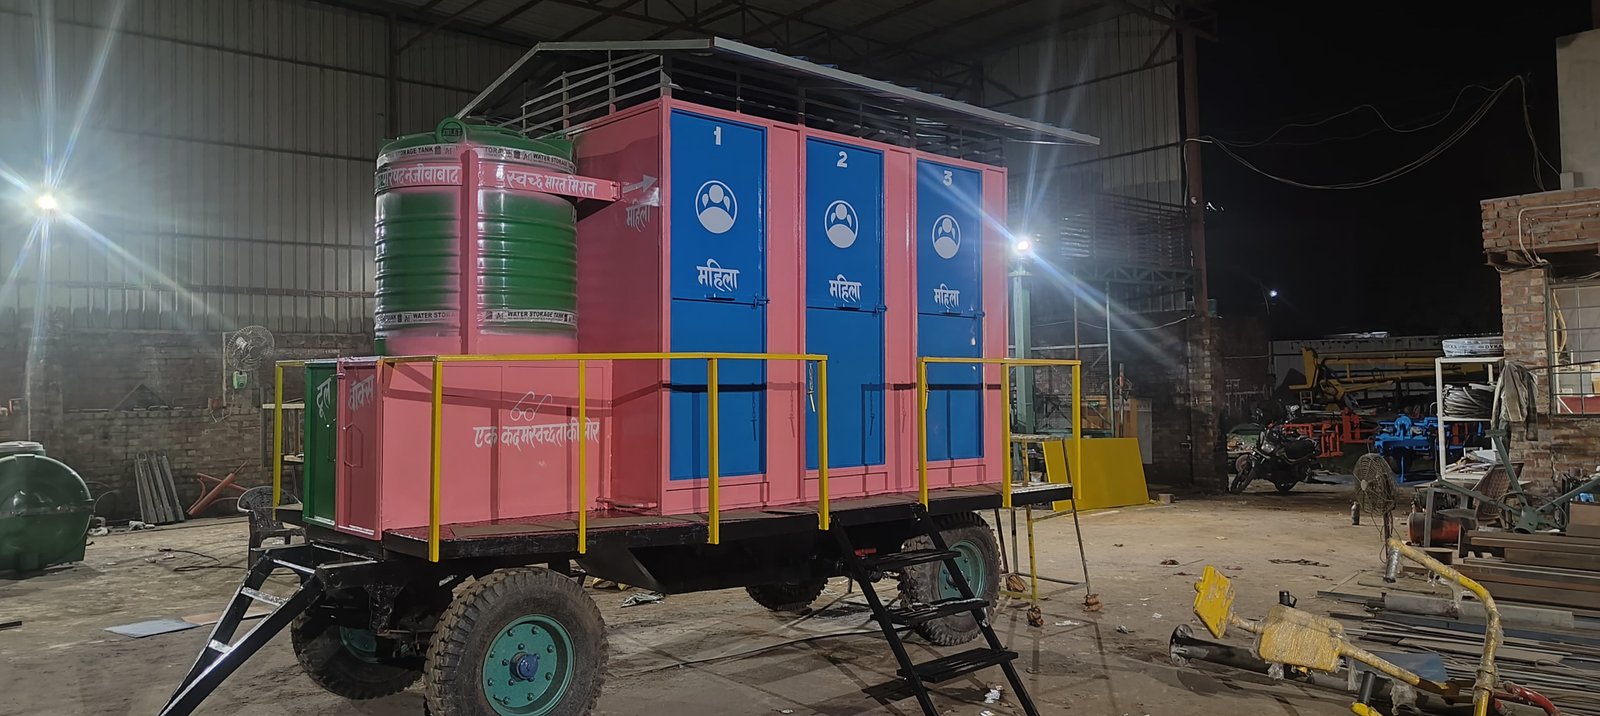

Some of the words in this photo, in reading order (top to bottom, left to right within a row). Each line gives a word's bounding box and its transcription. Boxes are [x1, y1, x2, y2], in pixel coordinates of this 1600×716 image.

[713, 126, 722, 146] 1
[418, 145, 434, 154] TANK
[533, 153, 550, 162] WATER
[836, 151, 848, 168] 2
[942, 170, 953, 186] 3
[696, 258, 740, 292] महिला
[829, 273, 862, 303] महिला
[933, 284, 960, 309] महिला
[473, 426, 498, 448] एक
